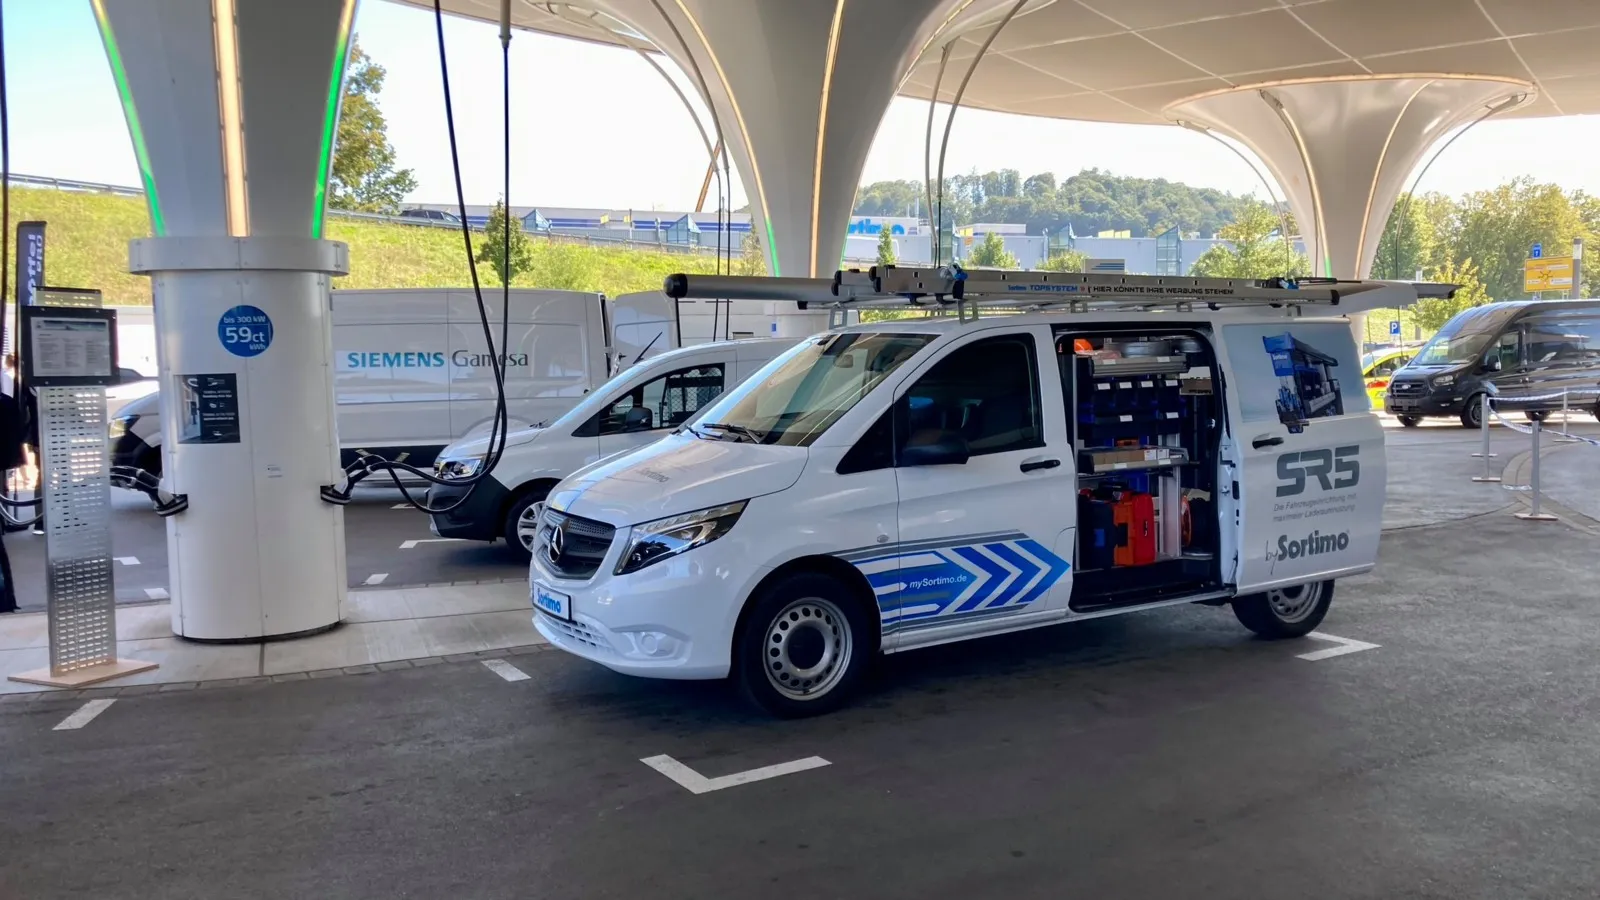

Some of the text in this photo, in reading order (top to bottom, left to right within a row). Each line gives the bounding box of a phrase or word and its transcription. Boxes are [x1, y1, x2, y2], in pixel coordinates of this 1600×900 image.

[1030, 284, 1078, 292] TOPSYSTEM
[1113, 285, 1145, 293] KÖNNTE
[1146, 286, 1164, 294] IHRE
[347, 351, 445, 368] SIEMENS
[1277, 529, 1349, 561] Sortimo
[909, 574, 968, 590] mySortimo.de
[537, 587, 562, 614] Sortimo
